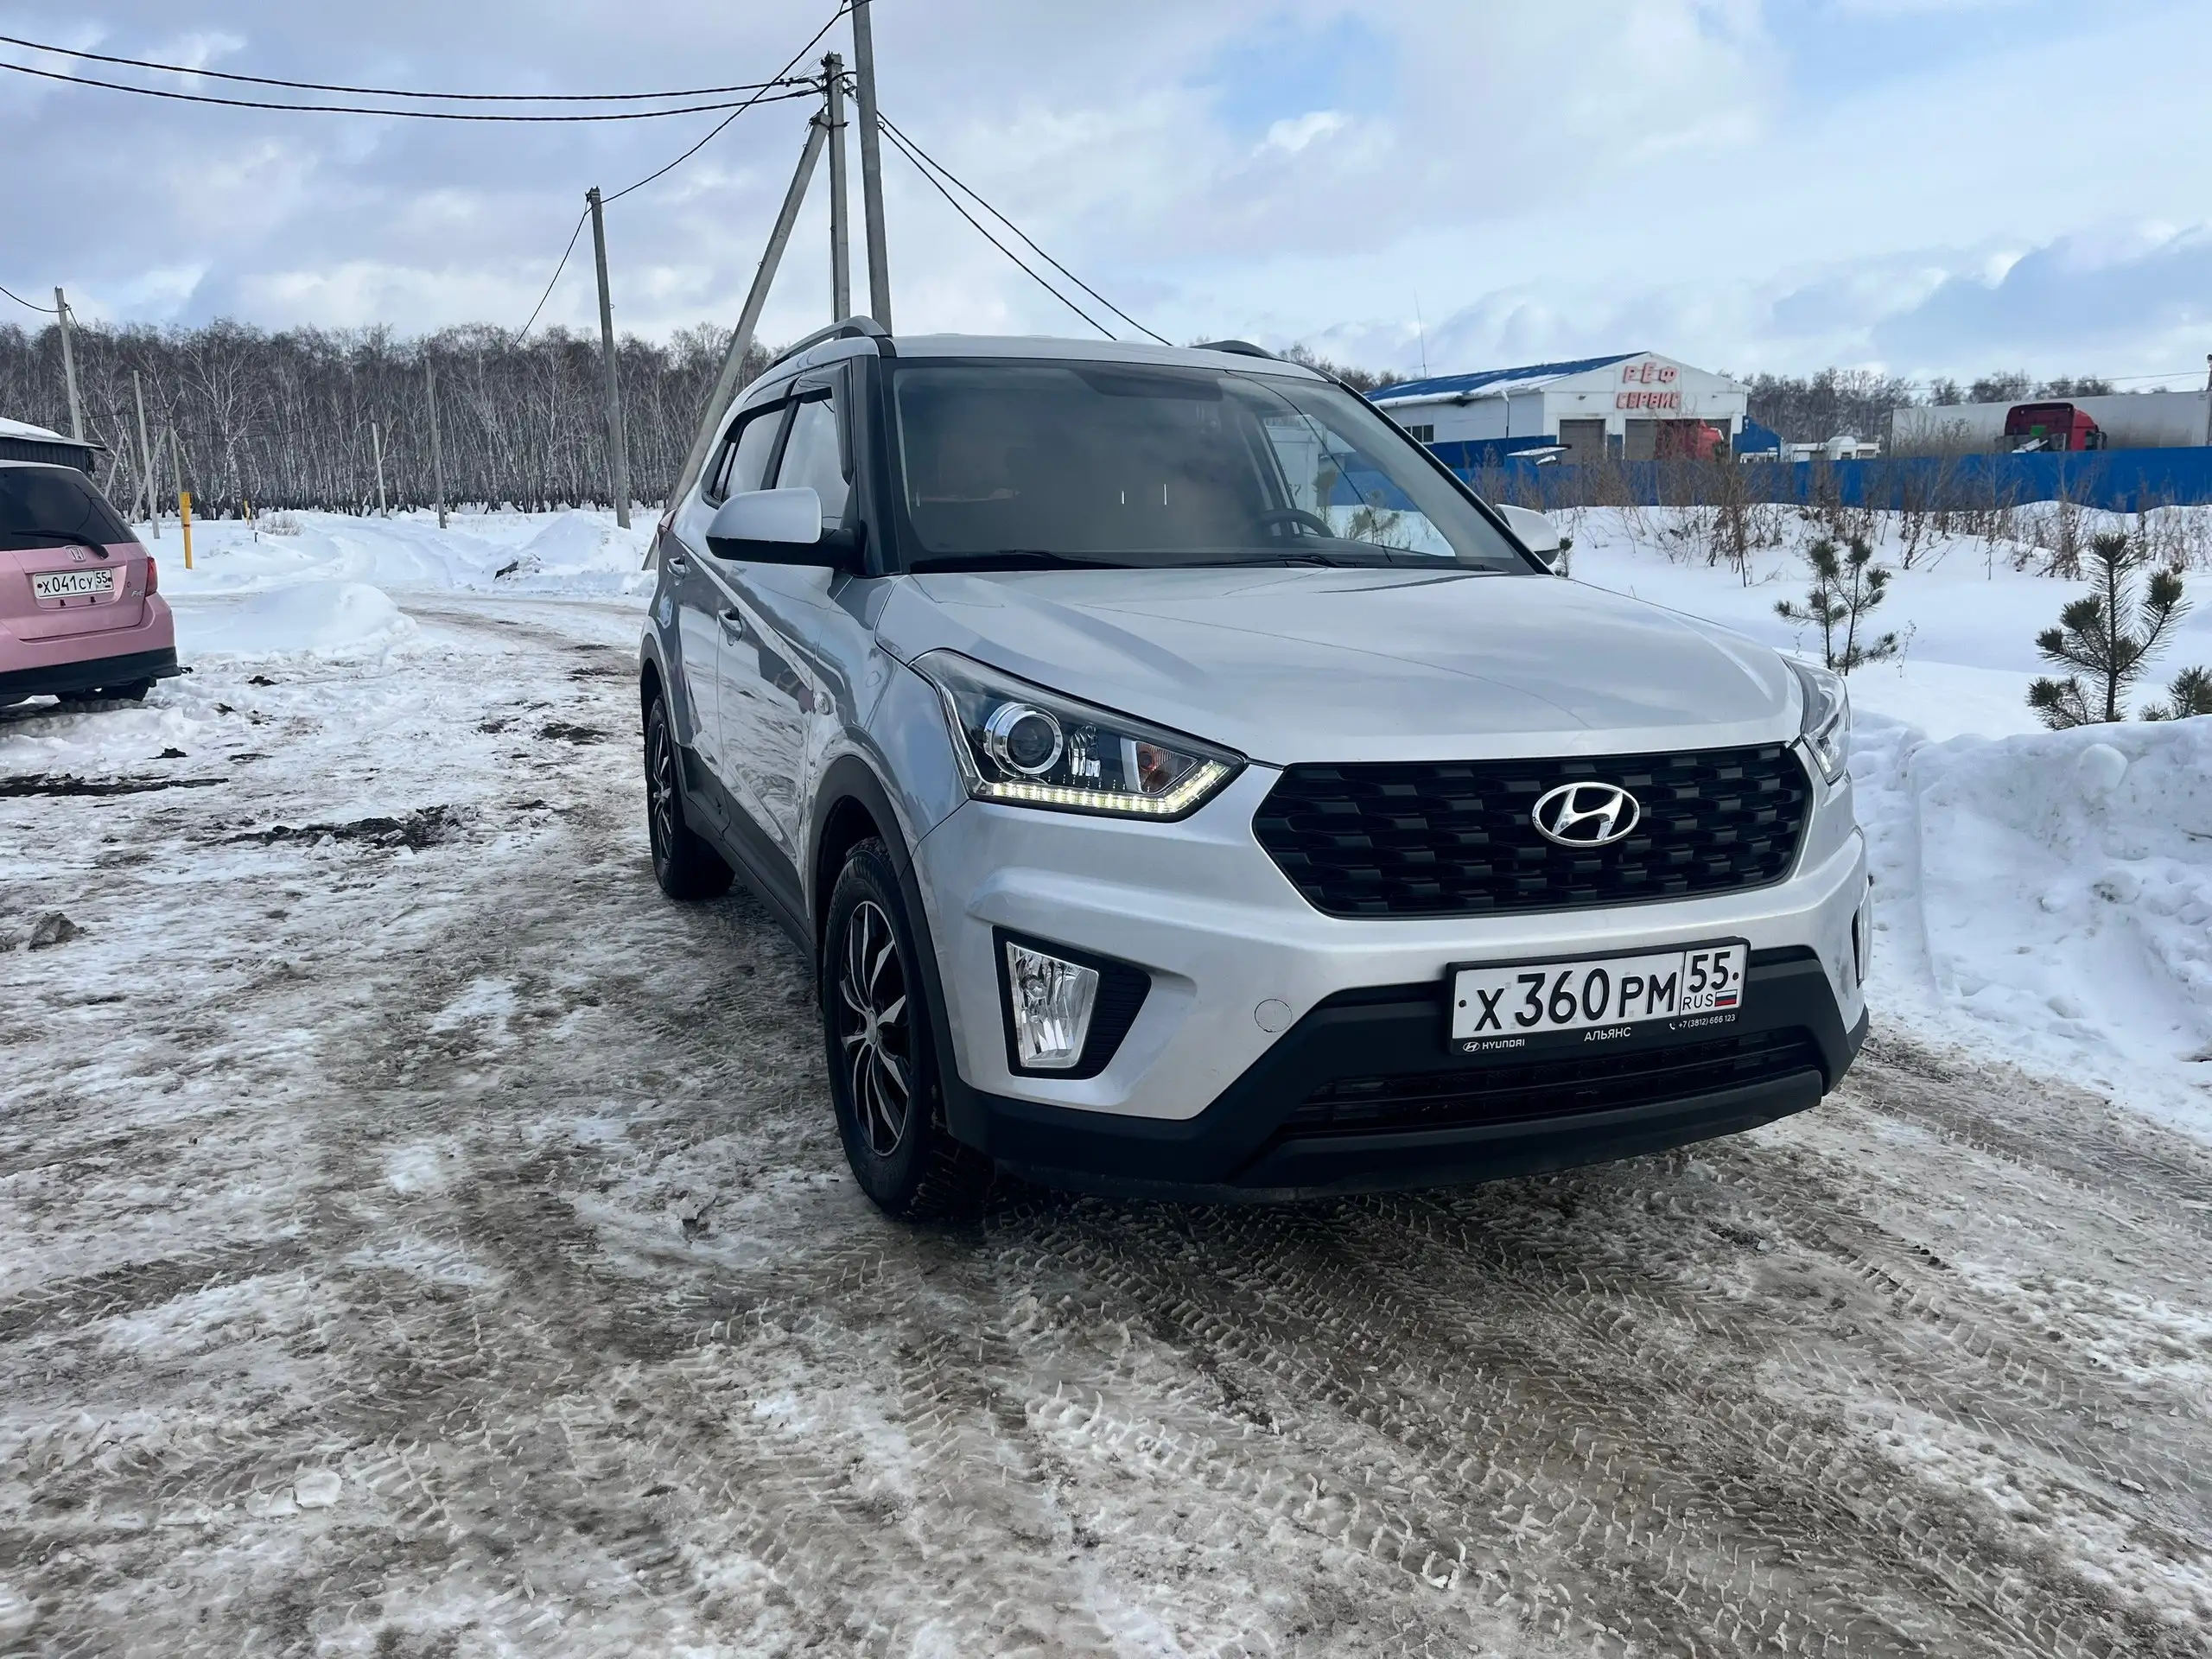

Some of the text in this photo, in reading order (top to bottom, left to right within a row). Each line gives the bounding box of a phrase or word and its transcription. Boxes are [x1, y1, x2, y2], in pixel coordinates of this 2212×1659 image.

[1622, 362, 1678, 385] РЕФ
[1616, 391, 1681, 410] СЕРВИС
[1688, 951, 1732, 993] 55
[1682, 993, 1714, 1011] RUS
[1584, 1027, 1631, 1042] АЛЬЯНС
[1482, 1039, 1525, 1050] HYUNDAI
